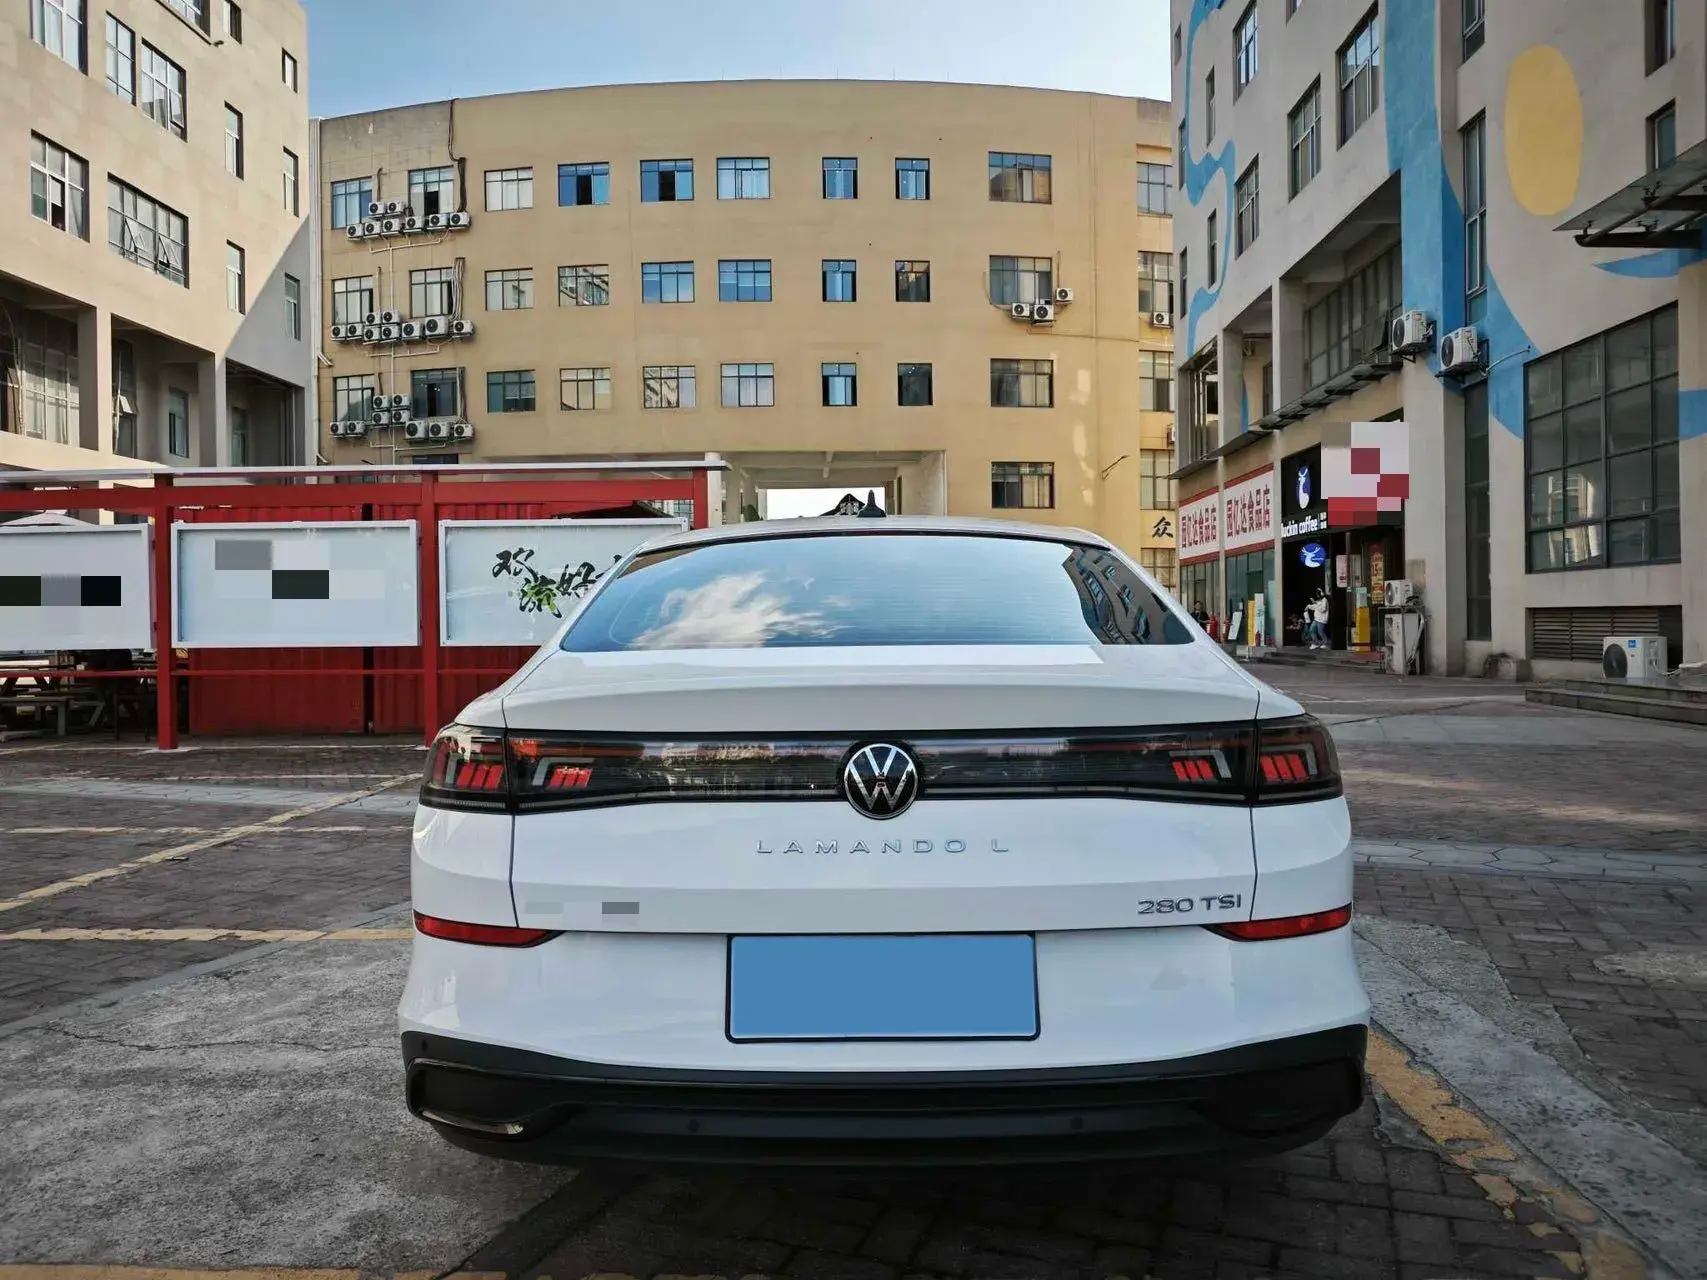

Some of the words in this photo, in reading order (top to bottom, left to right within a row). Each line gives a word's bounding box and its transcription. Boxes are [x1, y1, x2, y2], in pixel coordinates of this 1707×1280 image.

[1152, 516, 1174, 538] 众
[1299, 515, 1318, 534] coffee
[756, 839, 967, 854] LAMANDO
[991, 839, 1009, 853] L
[1137, 898, 1194, 915] 280
[1200, 894, 1242, 911] TSI
